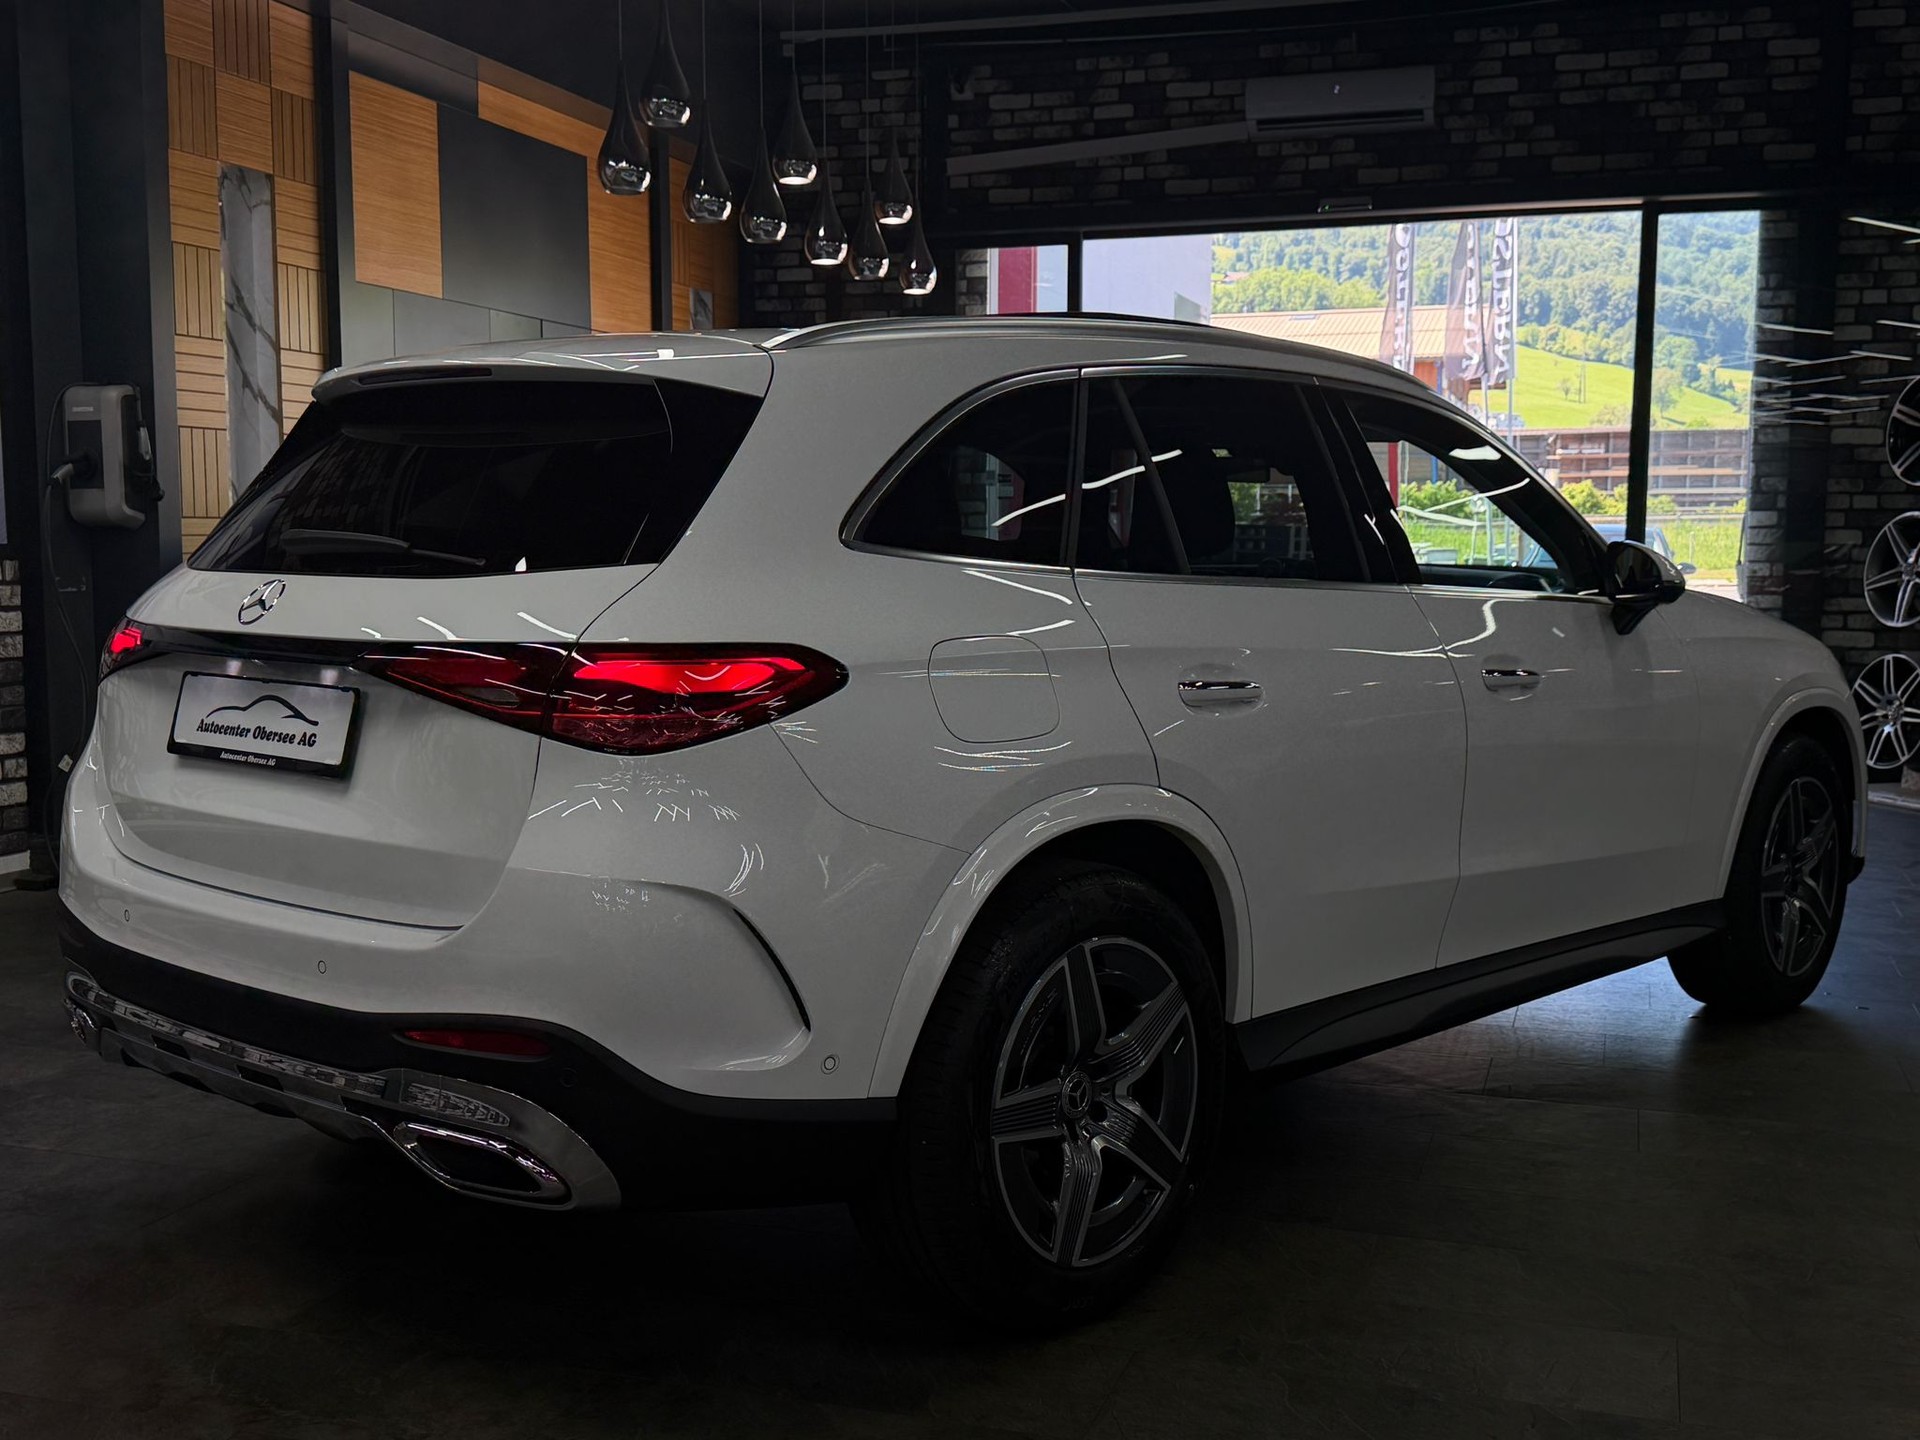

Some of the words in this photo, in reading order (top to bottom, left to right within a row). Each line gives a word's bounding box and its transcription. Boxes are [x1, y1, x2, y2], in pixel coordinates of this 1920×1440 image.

[196, 718, 251, 738] Autocenter
[252, 725, 296, 745] Obersee
[297, 731, 317, 747] AG
[219, 751, 247, 762] Autocenter
[247, 755, 267, 765] Obersee
[267, 758, 276, 766] AG
